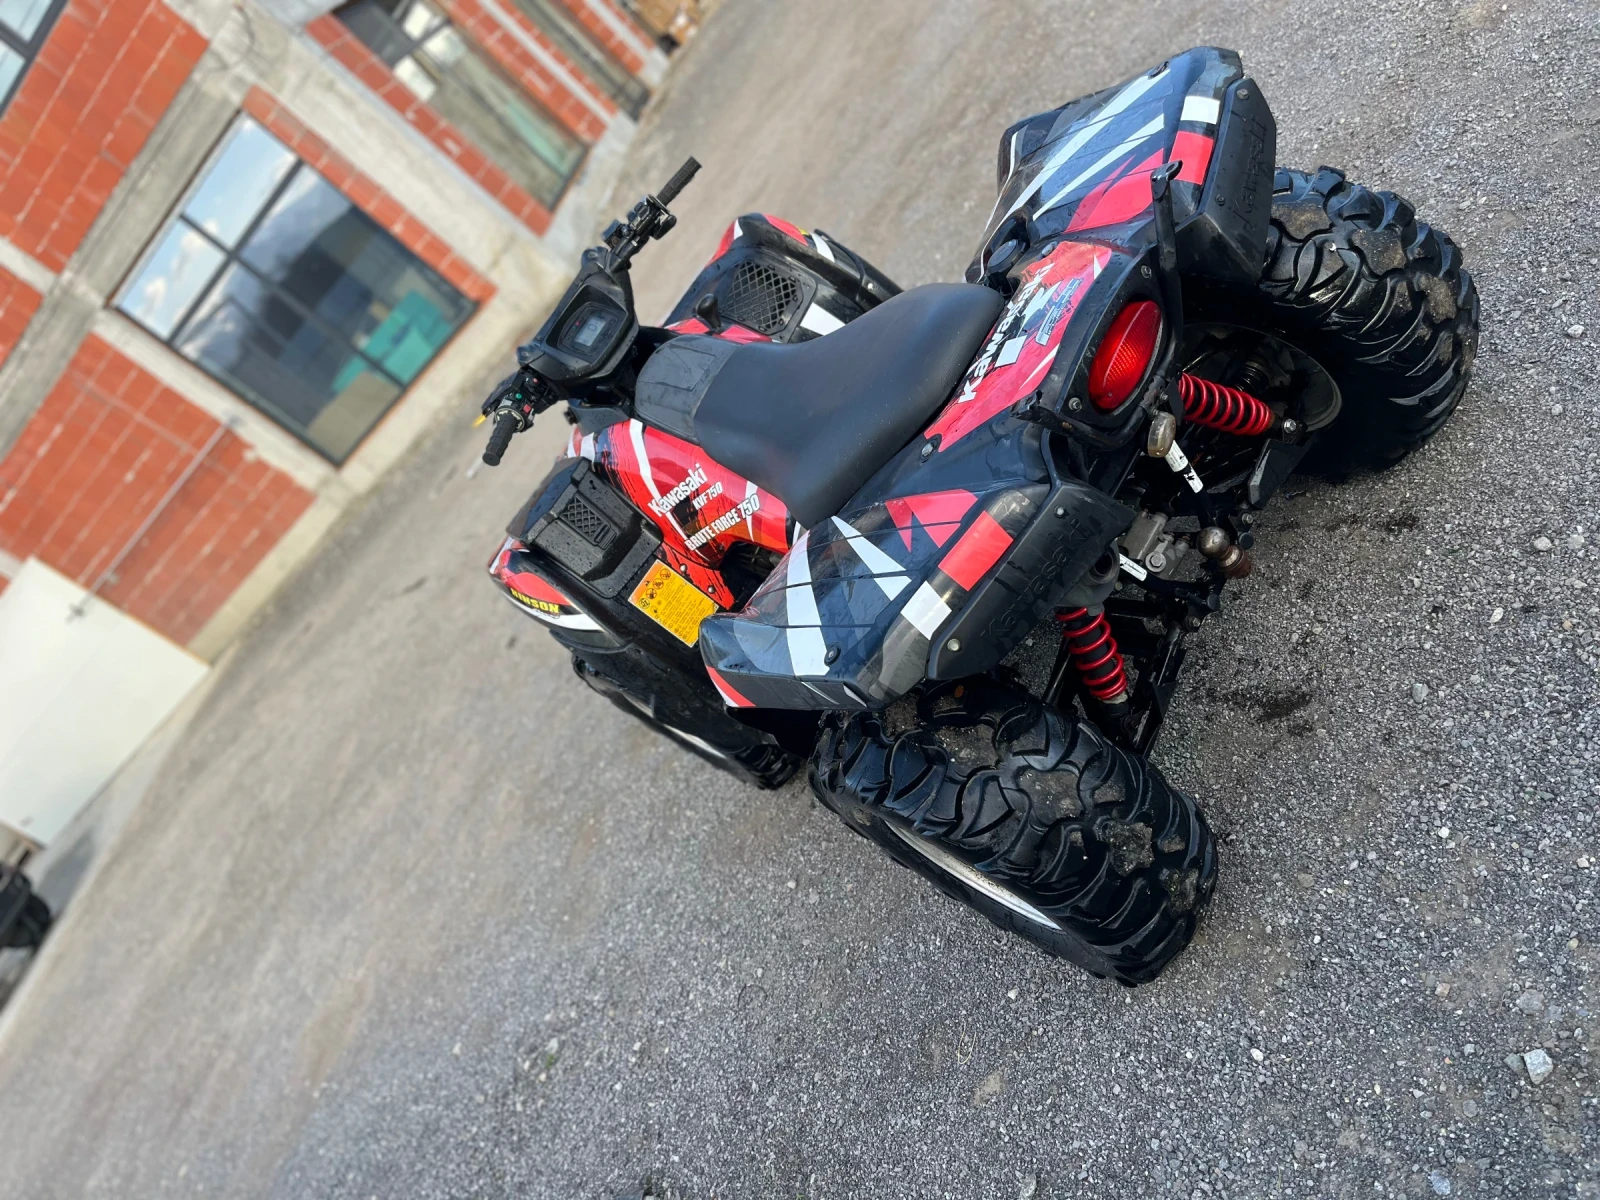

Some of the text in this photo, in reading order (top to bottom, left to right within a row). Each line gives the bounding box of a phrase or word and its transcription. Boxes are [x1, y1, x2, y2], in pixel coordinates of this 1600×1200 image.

[647, 462, 708, 517] Kawasaki
[684, 493, 760, 551] BRUTE FORCE 750
[979, 518, 1094, 648] Kawasaki
